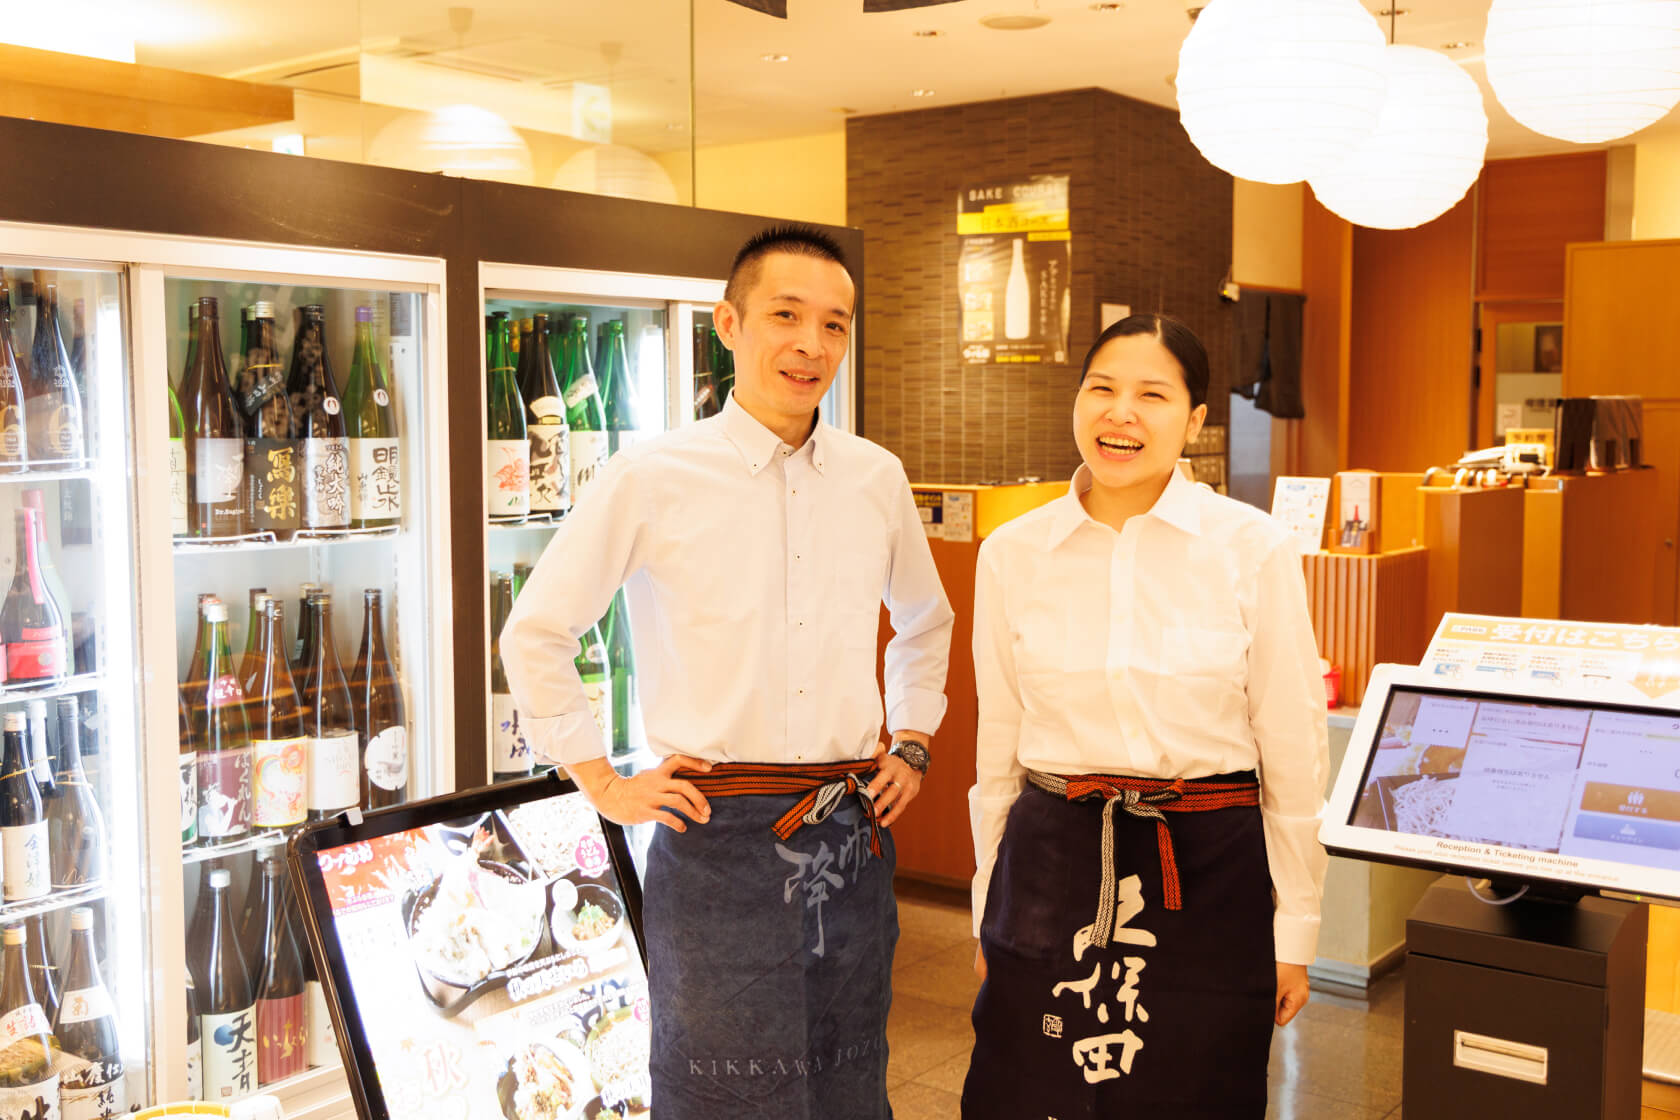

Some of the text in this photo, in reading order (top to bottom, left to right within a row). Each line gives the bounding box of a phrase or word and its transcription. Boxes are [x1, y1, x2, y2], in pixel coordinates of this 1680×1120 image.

[372, 446, 400, 512] 明鏡止水
[234, 751, 251, 822] ばくれん
[1436, 840, 1579, 868] Reception & Ticketing machine
[1051, 873, 1158, 1085] 久保田
[226, 1012, 255, 1094] 天青
[688, 1055, 823, 1077] KIKKAWA
